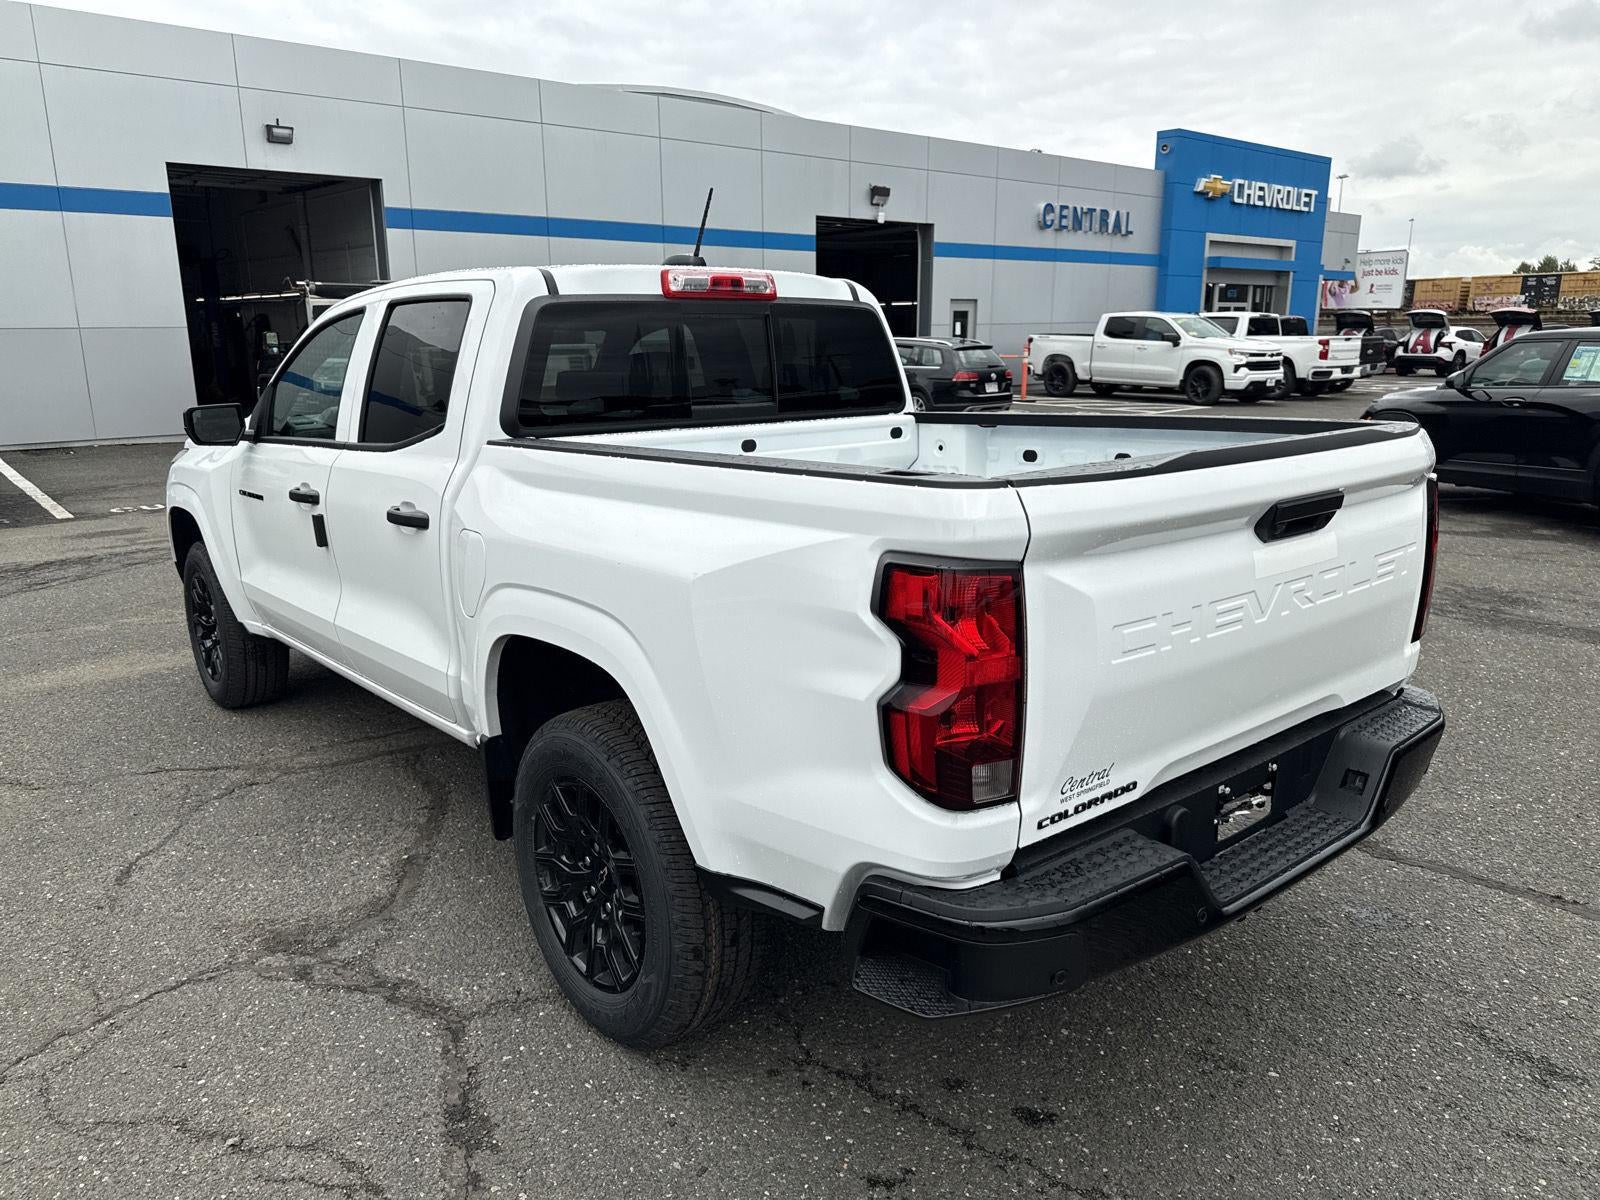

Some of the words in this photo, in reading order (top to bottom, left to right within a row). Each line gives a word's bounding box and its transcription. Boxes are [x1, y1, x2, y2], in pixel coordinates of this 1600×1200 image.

[1232, 178, 1318, 213] CHEVROLET
[1038, 202, 1134, 236] CENTRAL
[1360, 257, 1373, 266] Help
[1392, 255, 1405, 264] kids
[1361, 268, 1374, 278] just
[1375, 267, 1383, 276] be
[1111, 541, 1417, 664] CHEVROLET
[1060, 762, 1114, 795] Central
[1060, 793, 1076, 804] WEST
[1076, 779, 1111, 798] SPRINGFIELD
[1036, 780, 1138, 831] COLORADO
